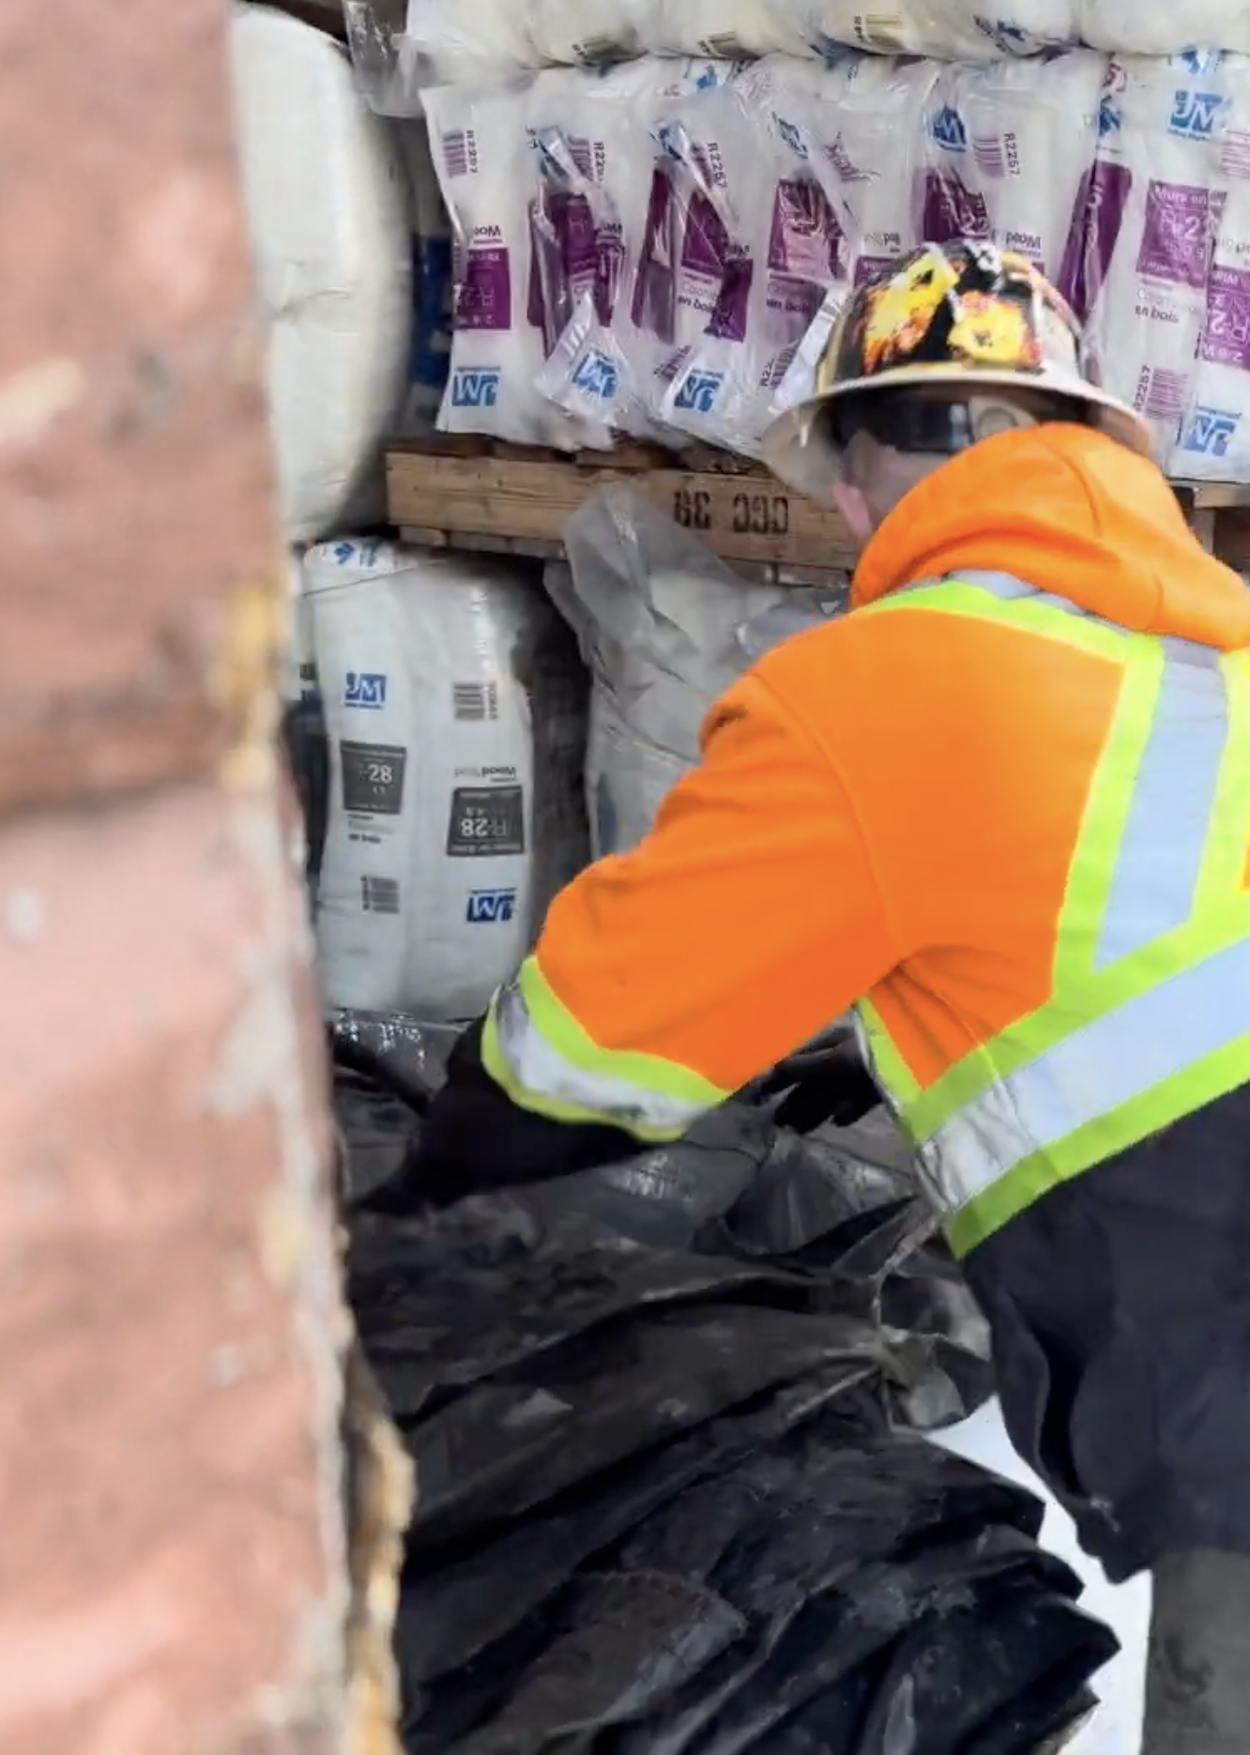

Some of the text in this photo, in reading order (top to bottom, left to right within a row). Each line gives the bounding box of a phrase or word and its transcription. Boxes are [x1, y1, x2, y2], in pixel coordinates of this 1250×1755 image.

[1003, 132, 1021, 176] R2257
[1006, 232, 1042, 249] Wood
[452, 373, 499, 407] JM
[346, 672, 387, 703] JM
